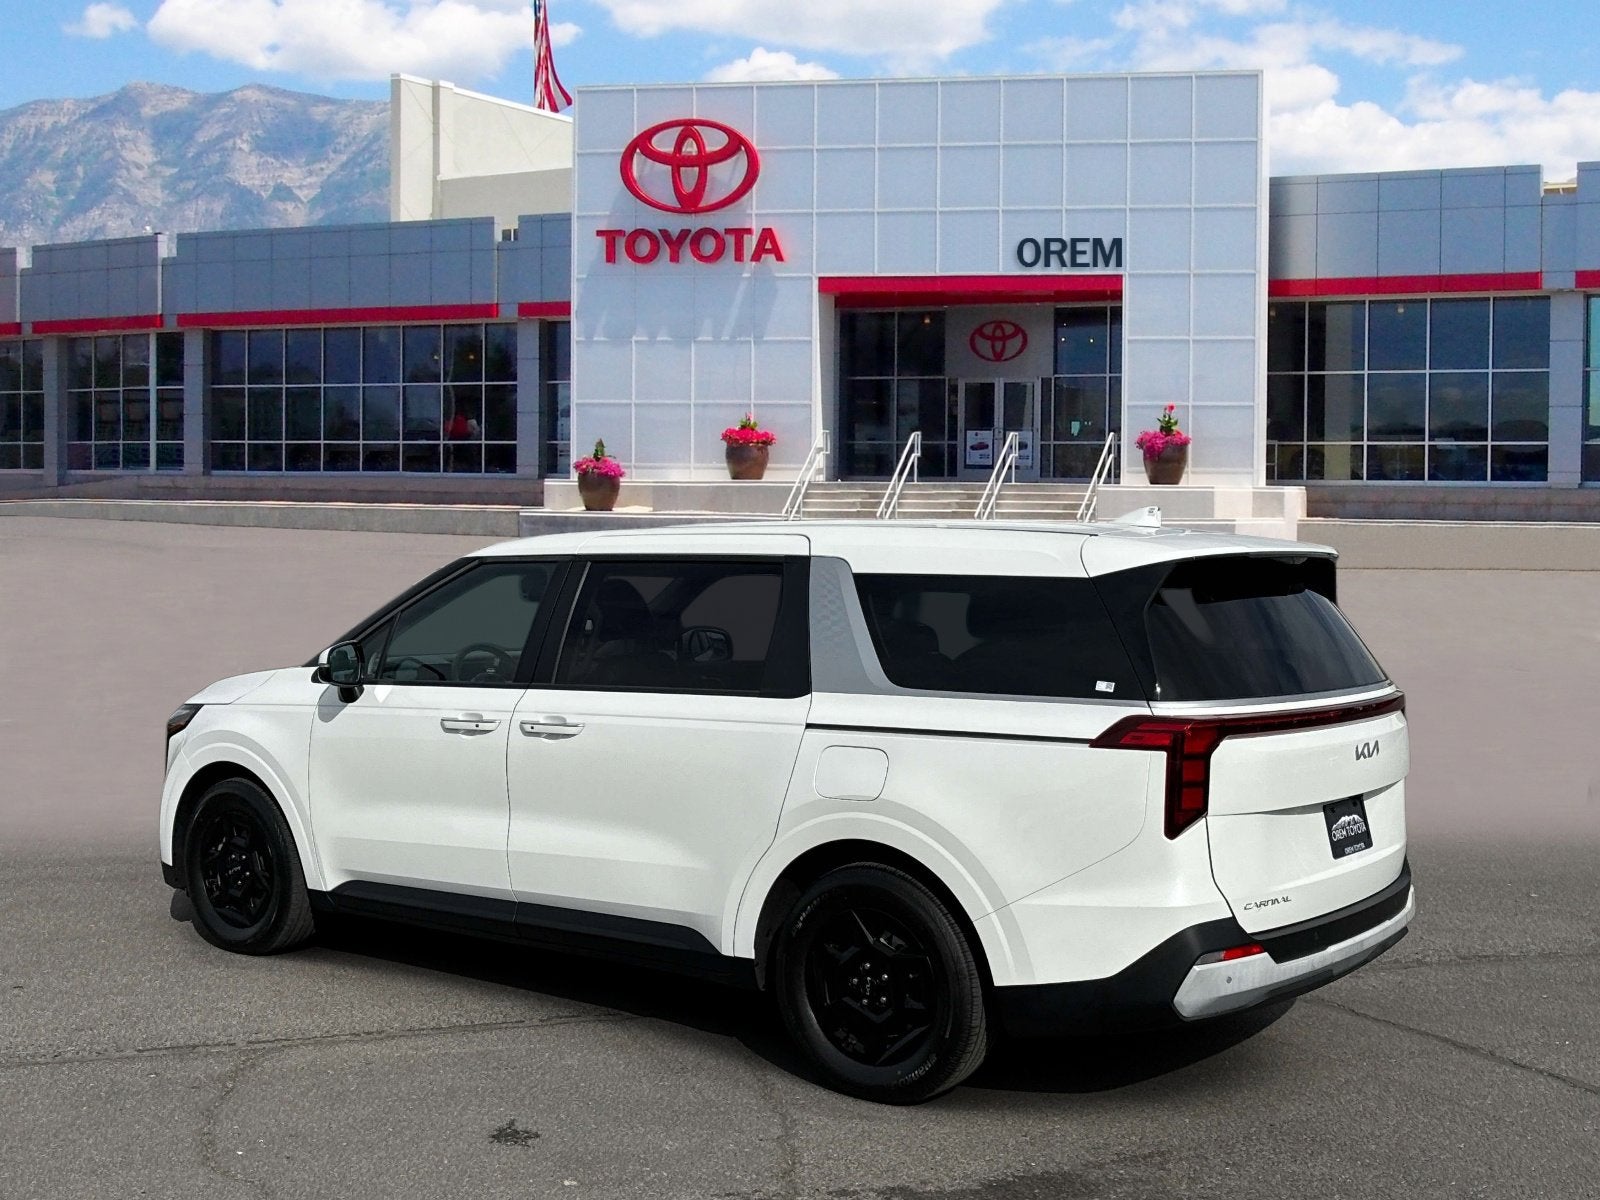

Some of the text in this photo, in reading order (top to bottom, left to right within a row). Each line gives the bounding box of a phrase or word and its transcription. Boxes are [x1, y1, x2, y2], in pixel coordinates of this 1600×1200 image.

[596, 227, 784, 264] TOYOTA
[1017, 238, 1122, 267] OREM
[1355, 740, 1379, 760] KIA
[1331, 822, 1366, 841] OREM TOYOTA
